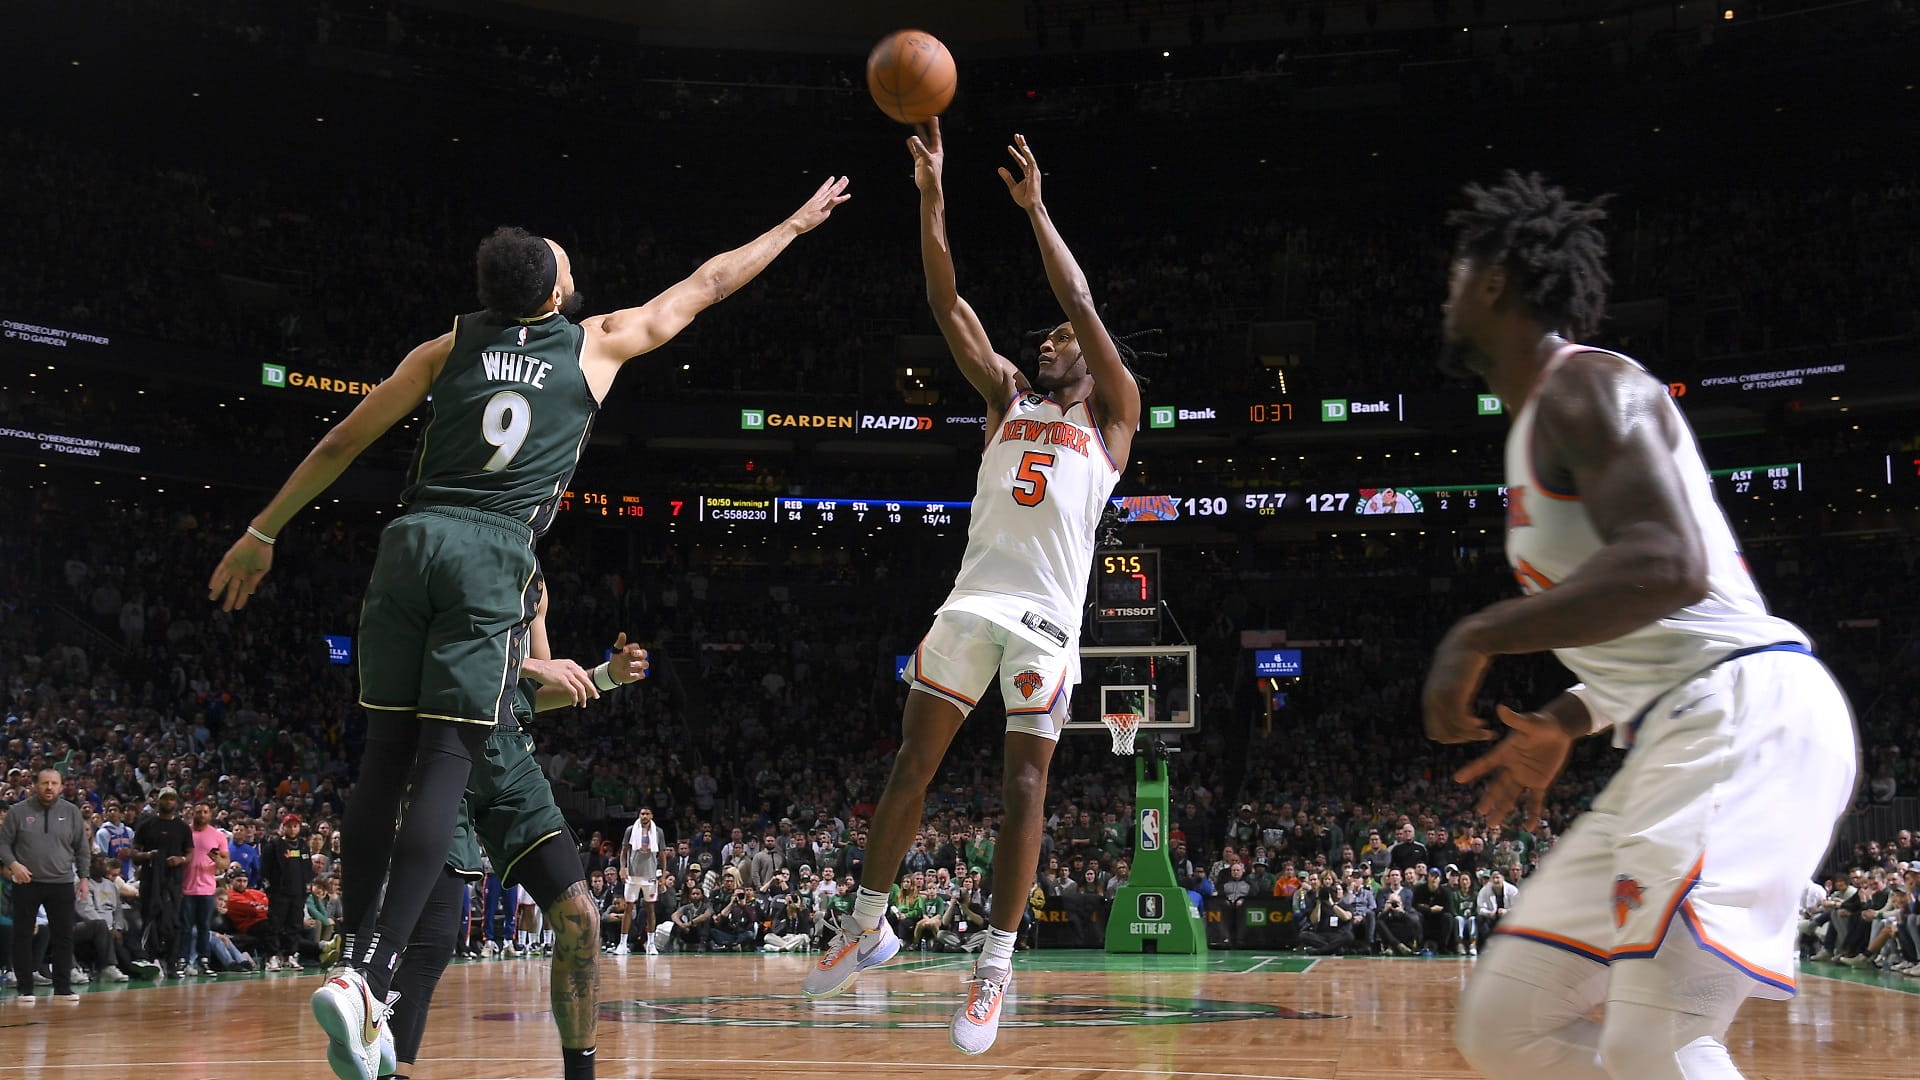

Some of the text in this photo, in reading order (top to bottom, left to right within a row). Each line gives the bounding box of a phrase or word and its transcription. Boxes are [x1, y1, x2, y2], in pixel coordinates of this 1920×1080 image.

[2, 320, 110, 345] CYBERSECURITY PARTNER
[4, 330, 68, 347] OF TD GARDEN
[481, 351, 553, 390] WHITE
[1701, 364, 1846, 387] OFFICIAL CYBERSECURITY PARTNER
[264, 367, 378, 396] TD GARDEN
[1742, 377, 1803, 391] OF TD GARDEN
[1324, 400, 1390, 418] TD Bank
[1479, 396, 1500, 411] TD
[743, 412, 853, 428] TD GARDEN
[946, 416, 978, 424] OFFICIAL
[1152, 408, 1216, 425] TD Bank
[1249, 403, 1292, 422] 10:37
[861, 415, 933, 430] RAPID7
[482, 390, 532, 472] 9
[0, 427, 141, 454] OFFICIAL CYBERSECURITY PARTNER
[999, 419, 1091, 459] NEW YORK
[40, 442, 101, 457] OF TD GARDEN
[1012, 450, 1056, 508] 5
[1731, 467, 1790, 481] AST REB
[1735, 479, 1787, 493] 27 53
[583, 493, 608, 505] 57.6
[706, 498, 731, 507] 50/50
[732, 499, 763, 509] winning
[1184, 497, 1228, 516] 130
[1245, 494, 1287, 509] 57.7
[1306, 493, 1350, 513] 127
[1440, 500, 1448, 510] 2
[1468, 499, 1476, 509] 5
[601, 507, 608, 516] 6
[627, 506, 644, 517] 130
[670, 501, 683, 516] 7
[784, 501, 945, 513] REB AST STL TO 3PT
[1259, 508, 1276, 516] OT2
[712, 510, 767, 520] C-5588230
[788, 511, 951, 526] 54 18 7 19 15/41
[1104, 556, 1141, 574] 57.5
[1131, 574, 1147, 600] 7
[1115, 607, 1156, 616] TISSOT
[1247, 910, 1265, 923] TD
[1130, 922, 1172, 935] GET THE APP
